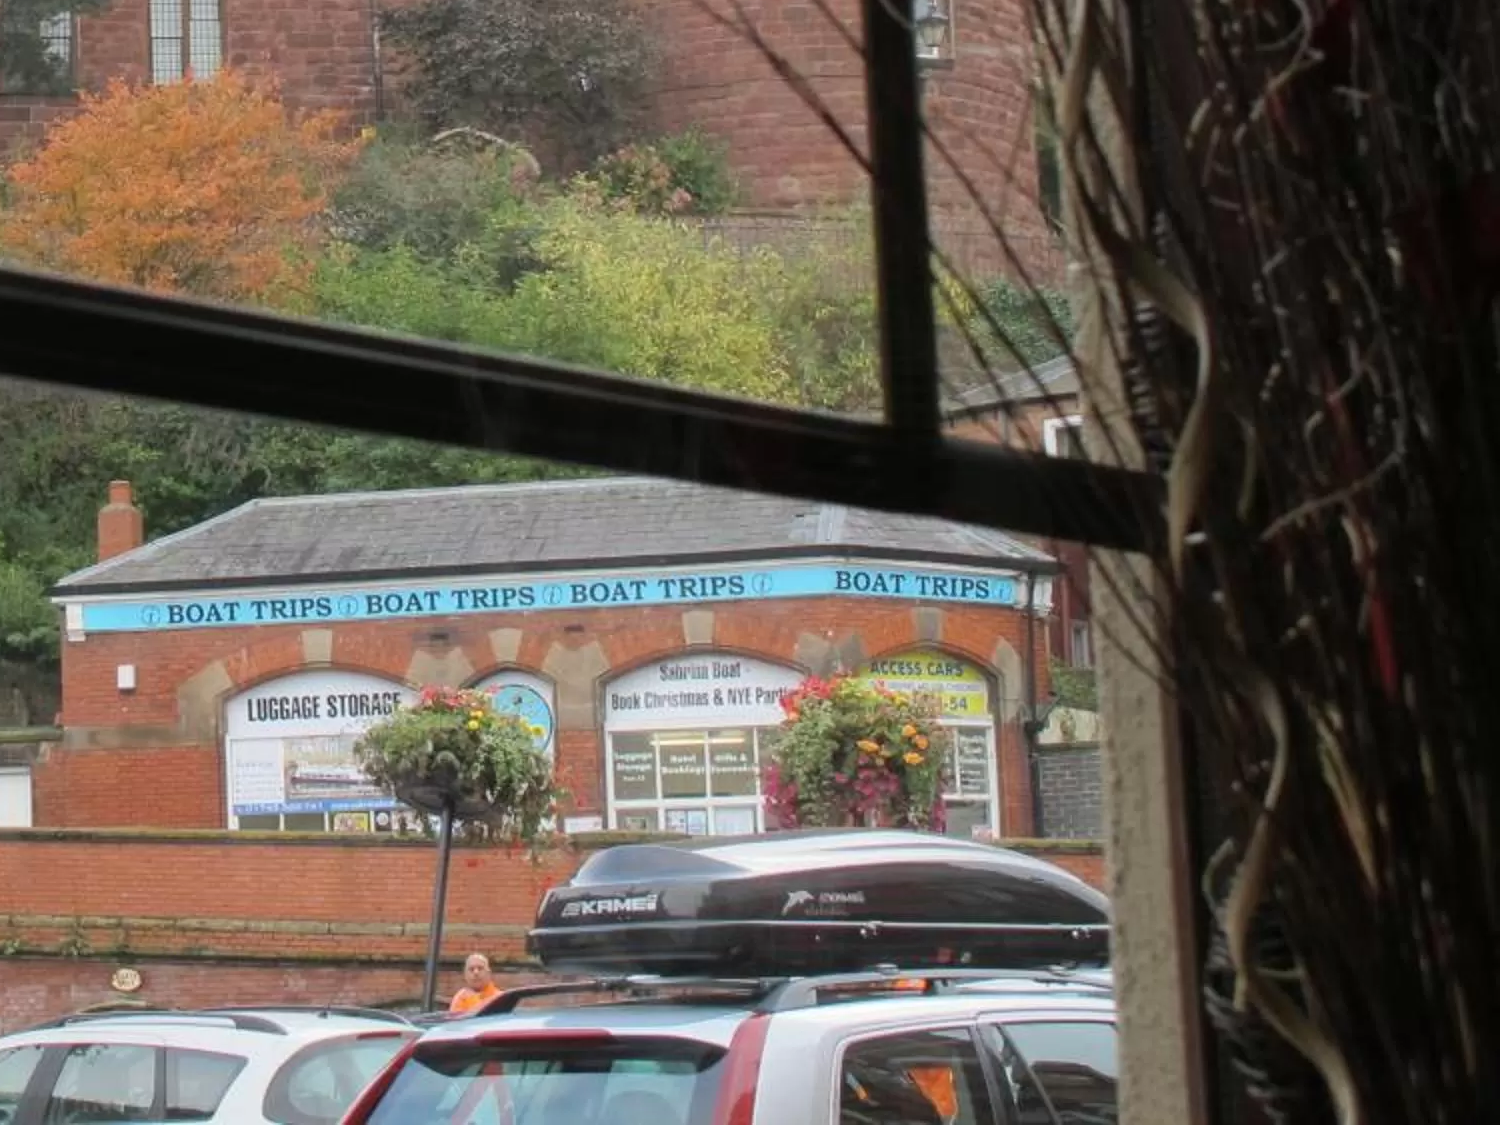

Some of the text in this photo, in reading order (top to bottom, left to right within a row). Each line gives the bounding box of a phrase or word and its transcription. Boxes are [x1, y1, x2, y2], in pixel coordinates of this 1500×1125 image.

[835, 570, 990, 599] BOAT TRIPS
[167, 575, 745, 624] BOAT TRIPS BOAT TRIPS BOAT TRIPS
[711, 661, 741, 679] Boat
[870, 660, 921, 676] ACCESS
[247, 691, 401, 722] LUGGAGE STORAGE
[611, 691, 640, 710] Book
[644, 688, 709, 709] Christmas
[713, 688, 724, 706] &
[728, 686, 751, 706] NYE
